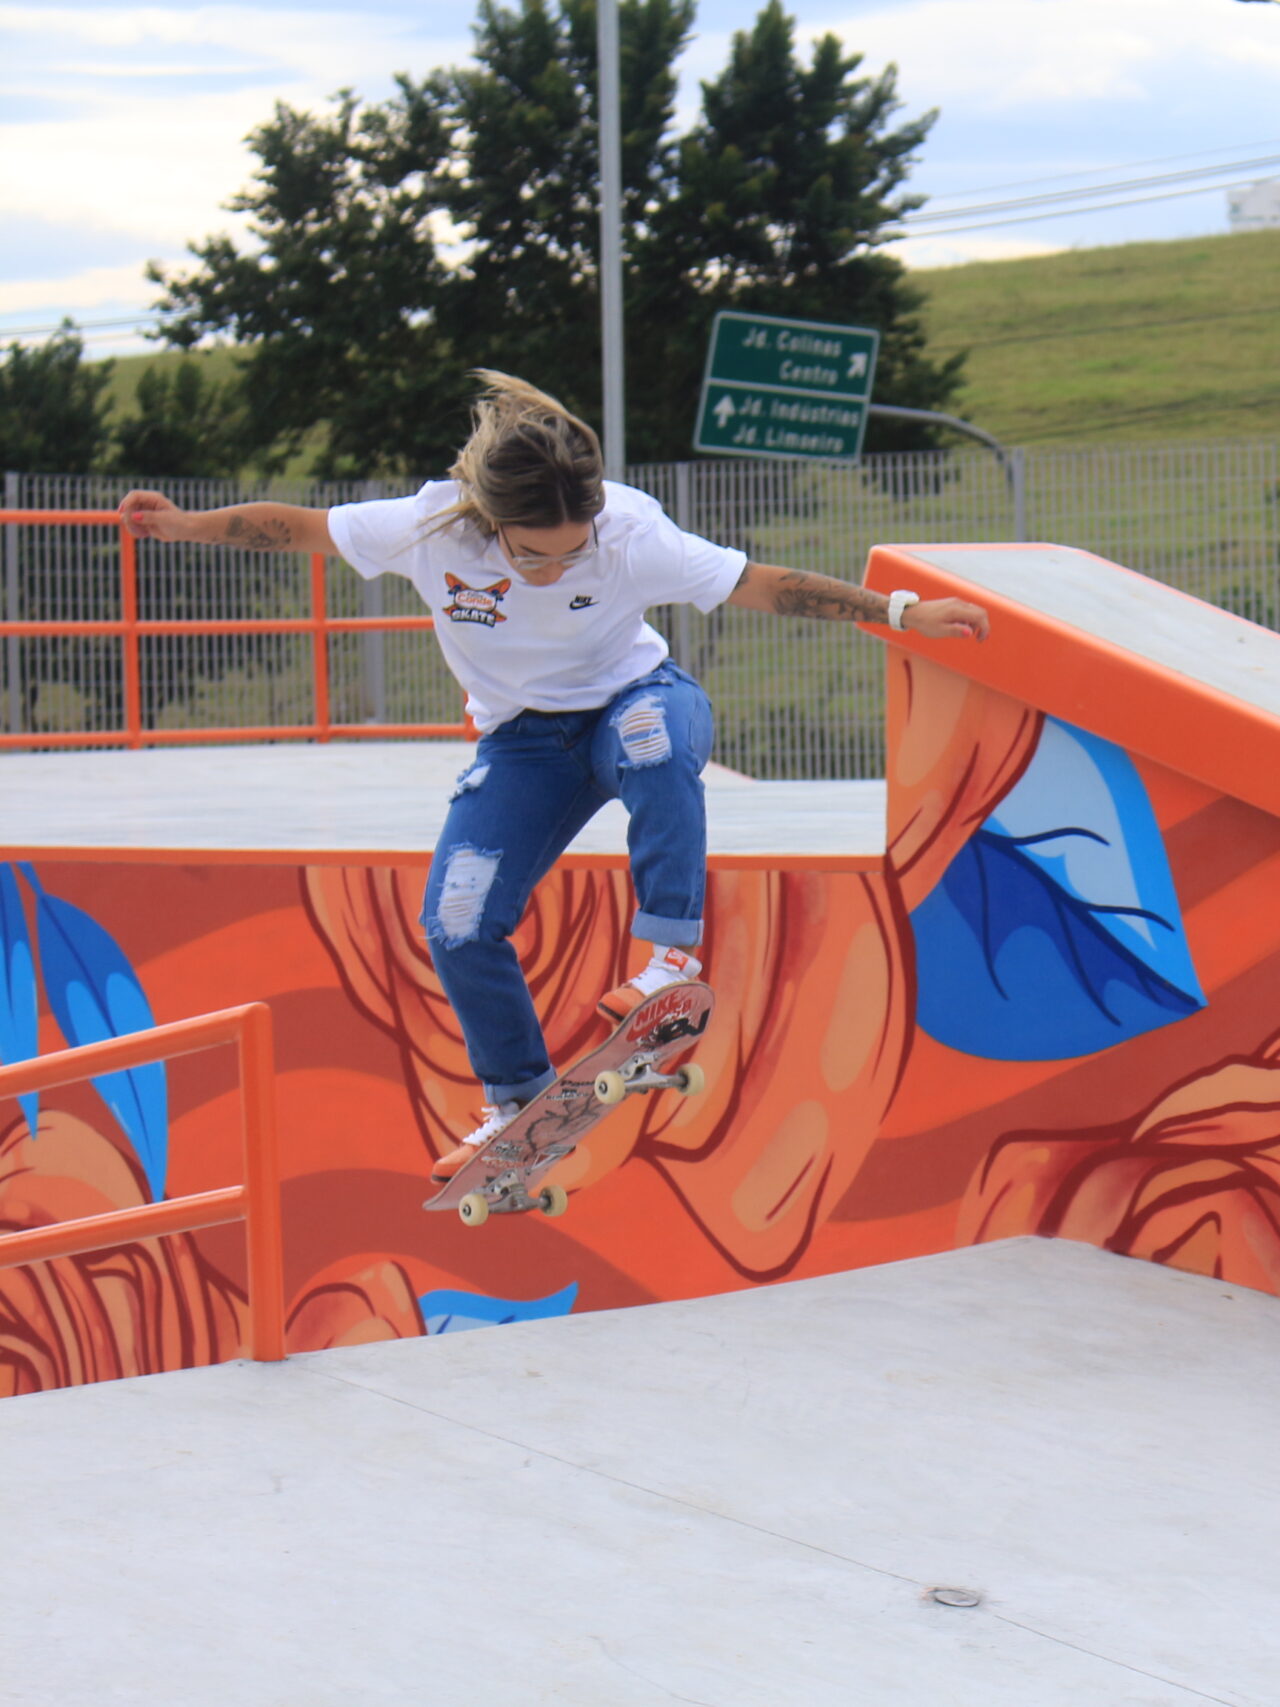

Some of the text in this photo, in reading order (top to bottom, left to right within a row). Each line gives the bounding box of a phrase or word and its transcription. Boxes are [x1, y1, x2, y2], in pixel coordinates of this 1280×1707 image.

[776, 330, 843, 358] Colinas
[778, 358, 839, 386] Centro
[765, 426, 845, 453] Limoeiro
[451, 608, 495, 627] SKATE
[636, 989, 681, 1027] NIKE
